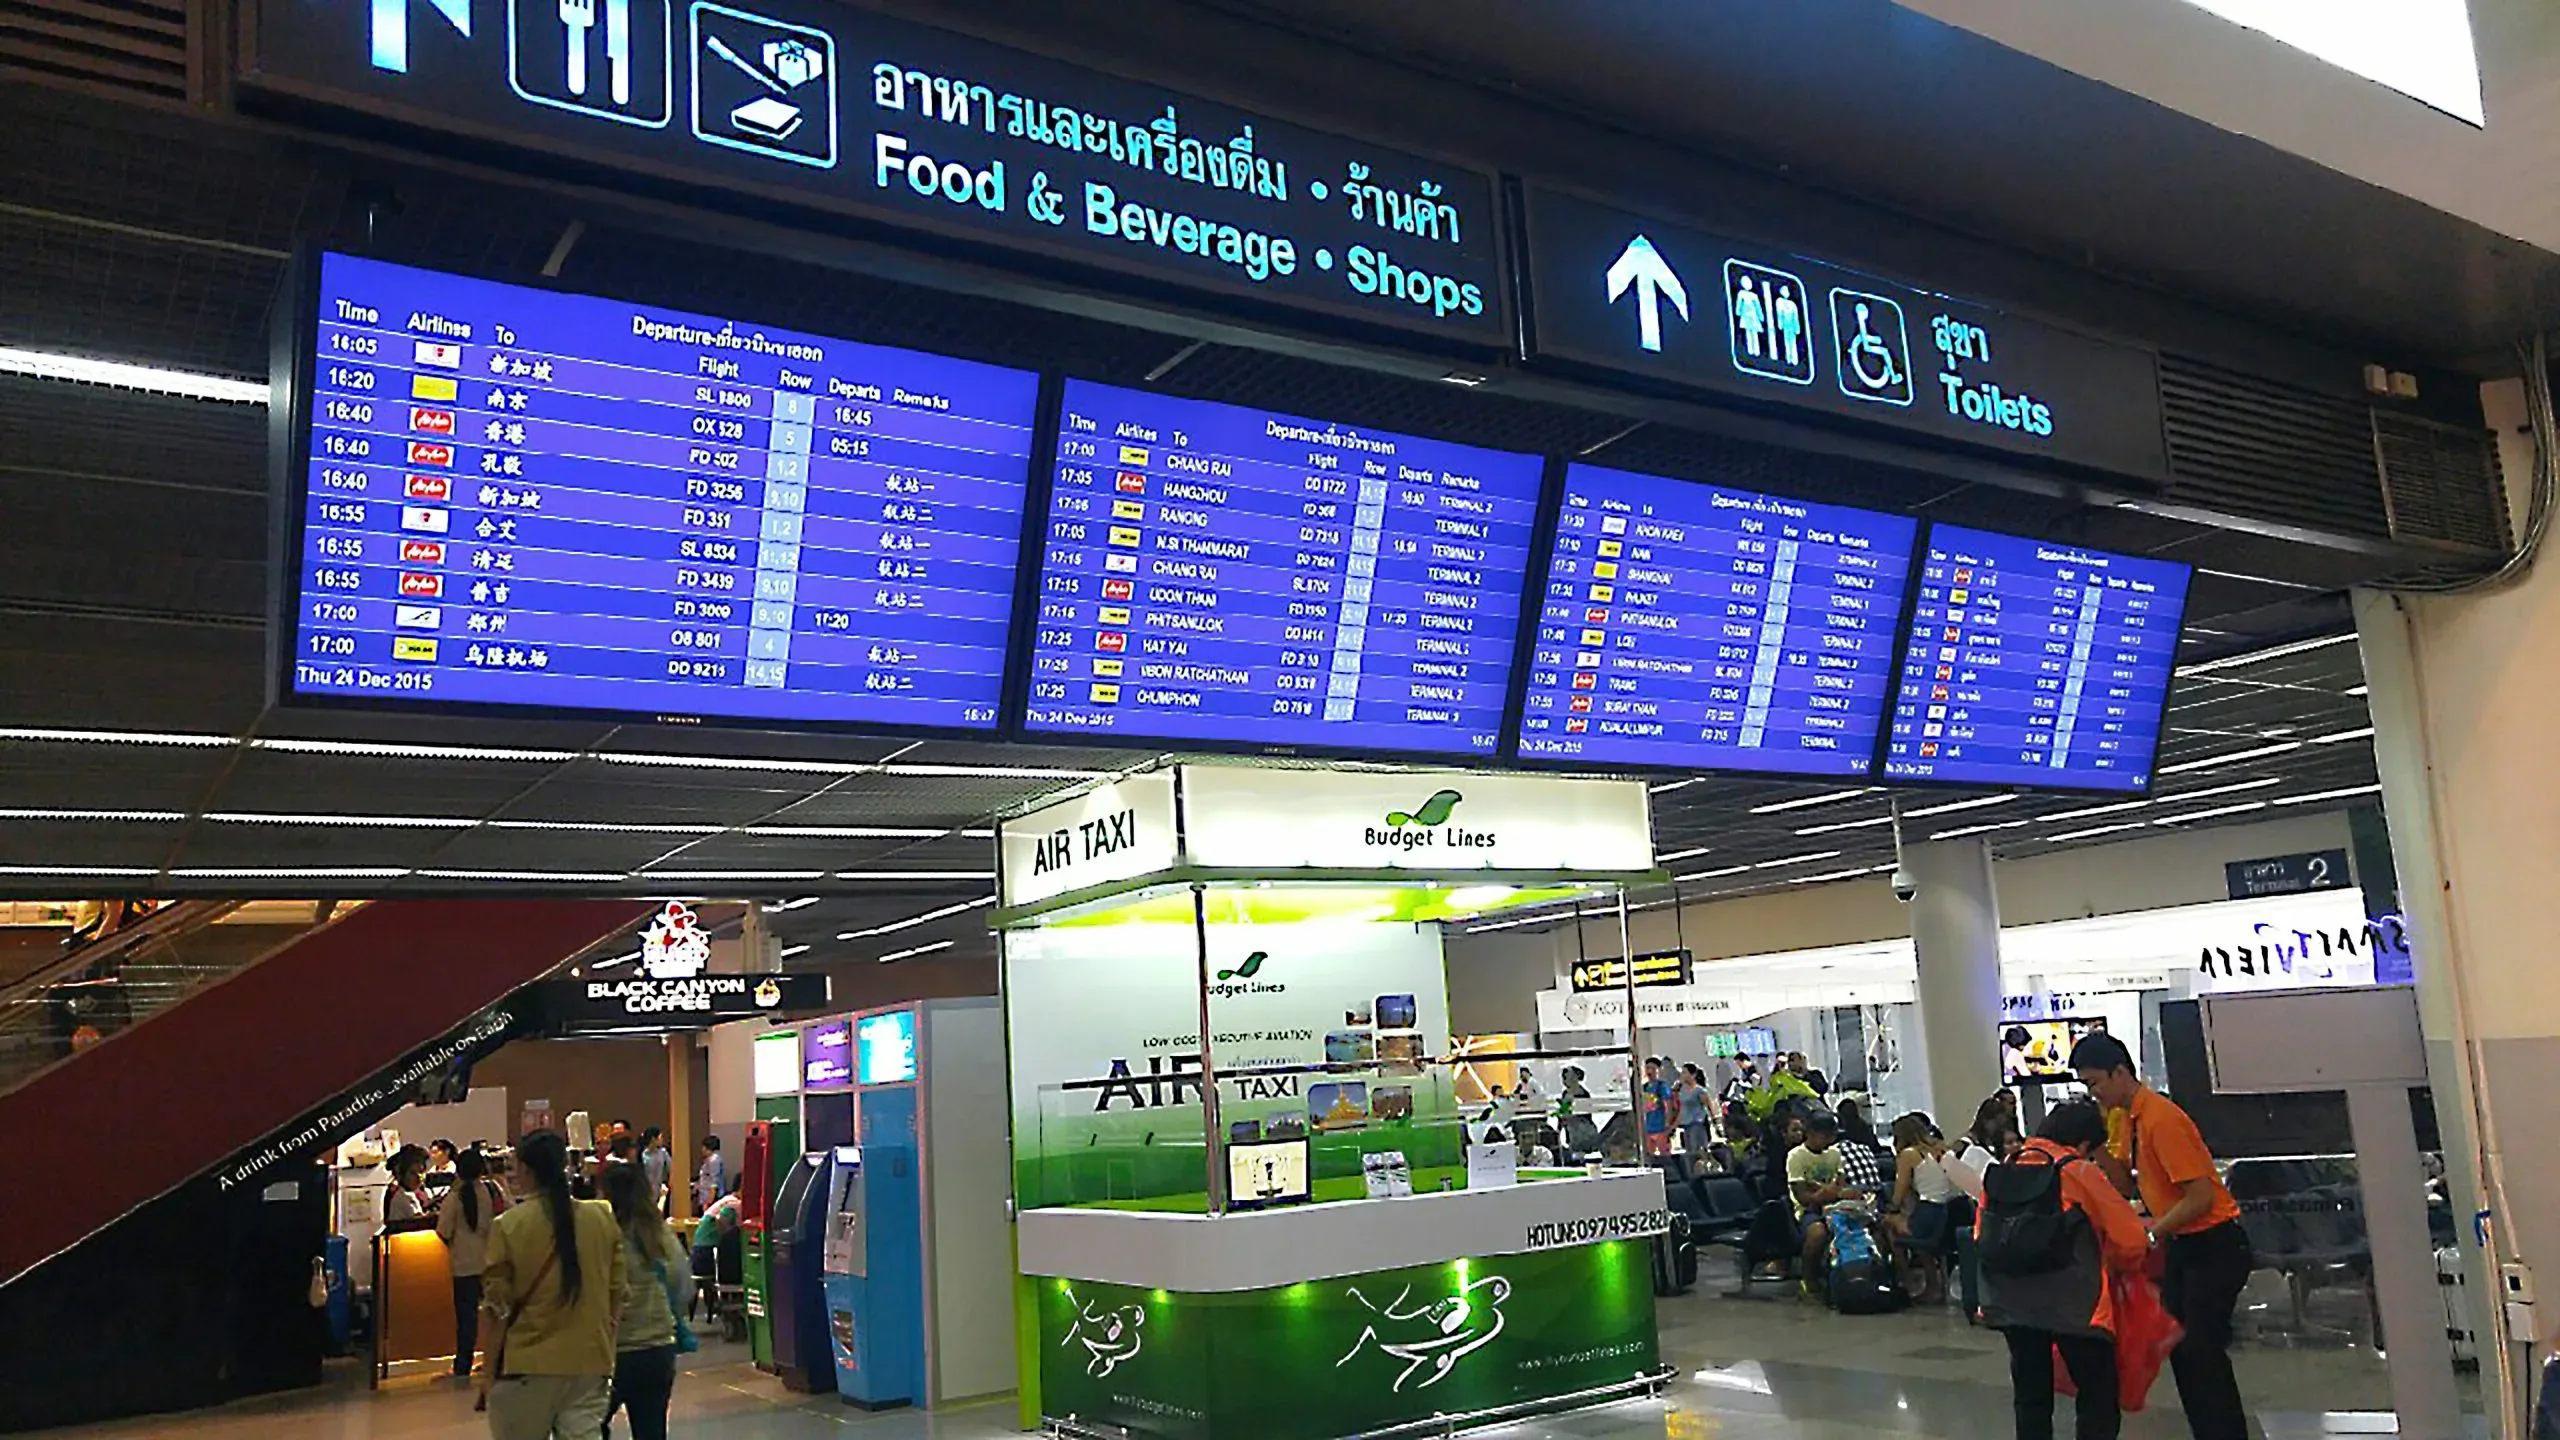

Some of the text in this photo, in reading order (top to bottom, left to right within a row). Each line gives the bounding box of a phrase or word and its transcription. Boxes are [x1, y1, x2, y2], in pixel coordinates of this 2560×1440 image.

[873, 62, 1460, 244] อาหารและเครื่องดื่ม ร้านค้า
[875, 133, 1484, 317] Food & Beverage Shops
[330, 332, 377, 355] 16:05
[335, 298, 379, 323] Time
[406, 312, 471, 338] Airlines
[494, 324, 515, 345] To
[697, 355, 739, 379] Flight
[778, 368, 812, 389] Row
[828, 376, 881, 401] Departs
[328, 366, 375, 390] 16:20
[326, 400, 372, 423] 16:40
[694, 386, 716, 403] SL
[834, 406, 872, 426] 16:45
[1939, 372, 2052, 436] Toilets
[323, 435, 369, 455] 16:40
[692, 416, 716, 435] OX
[830, 436, 869, 455] 05:15
[1172, 430, 1188, 447] To
[688, 448, 711, 465] FD
[321, 468, 367, 490] 16:40
[686, 478, 708, 496] FD
[477, 484, 541, 509] 新加坡
[318, 503, 365, 523] 16:55
[682, 507, 705, 526] FD
[316, 536, 362, 557] 16:55
[679, 539, 701, 557] SL
[314, 568, 360, 589] 16:55
[676, 568, 699, 586] FD
[1046, 576, 1079, 593] 17:15
[312, 602, 357, 621] 17:00
[673, 599, 696, 615] FD
[309, 634, 355, 654] 17:00
[694, 630, 721, 648] 801
[296, 665, 331, 684] Thu
[357, 669, 391, 688] Dec
[393, 671, 432, 690] 2015
[1034, 808, 1135, 876] AIR TAXI
[1365, 826, 1496, 851] Budget Lines
[2308, 857, 2331, 885] 2
[588, 979, 745, 998] BLACK CANYON
[1204, 982, 1247, 998] udget
[625, 994, 711, 1013] COFFEE
[1234, 1076, 1298, 1100] TAXI
[220, 1175, 234, 1191] A
[236, 1152, 284, 1181] drink
[279, 1127, 319, 1156] from
